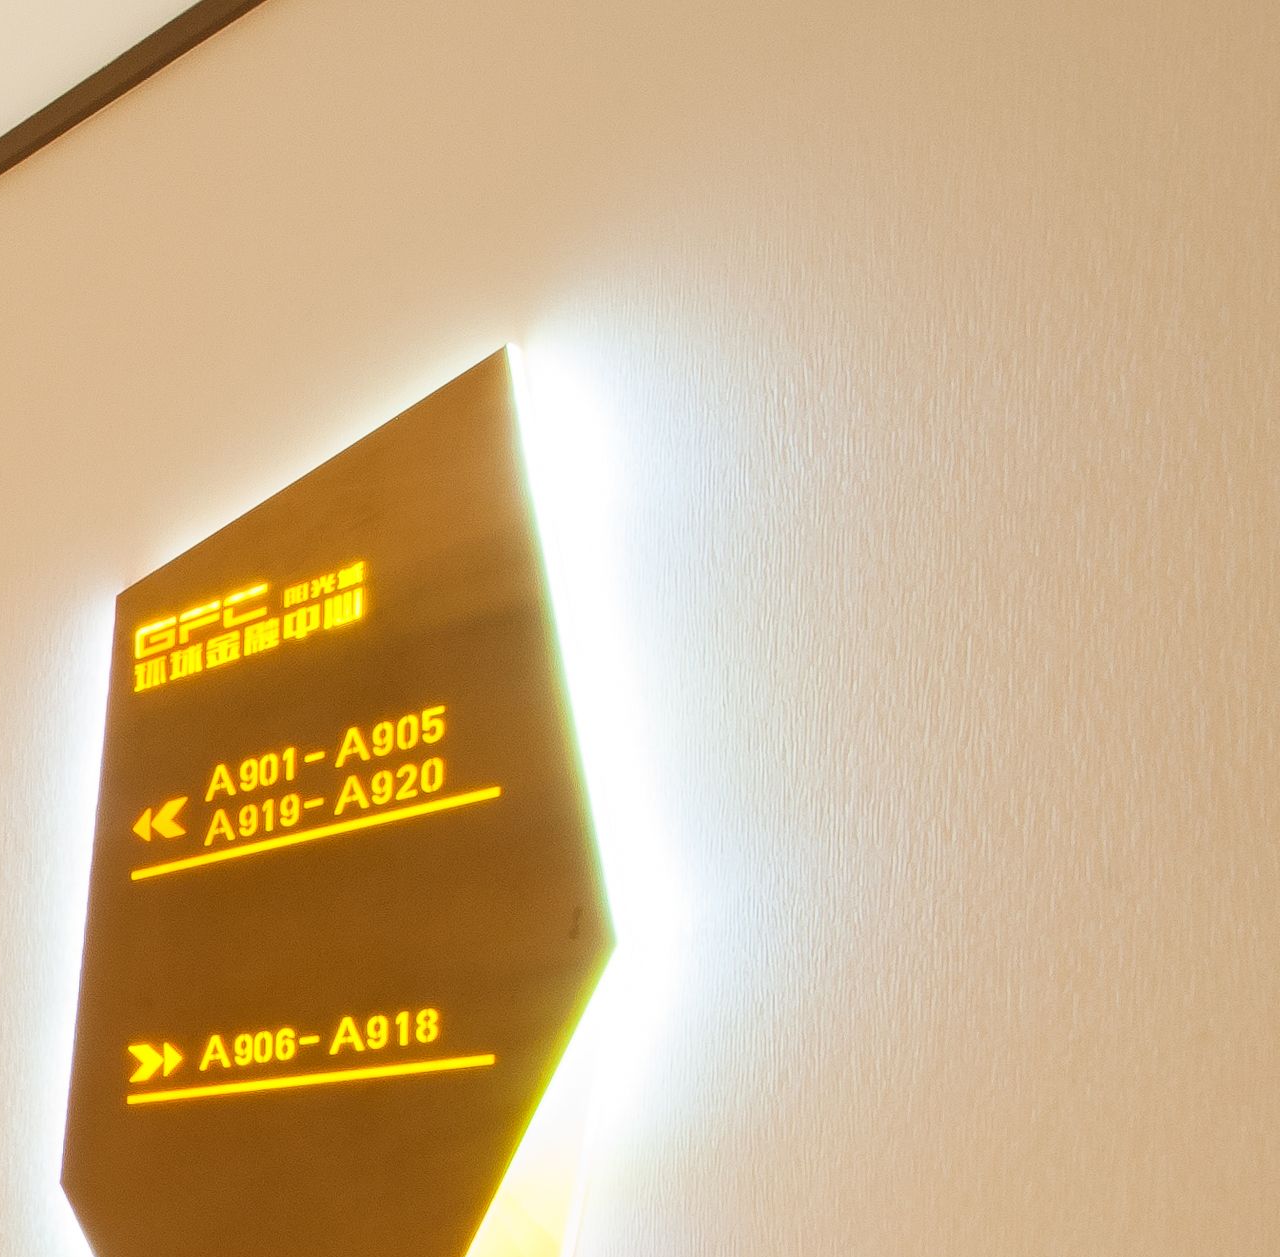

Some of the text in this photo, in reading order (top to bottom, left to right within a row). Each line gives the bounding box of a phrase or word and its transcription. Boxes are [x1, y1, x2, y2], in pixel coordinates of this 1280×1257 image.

[133, 586, 367, 693] 环球金融中心
[134, 581, 269, 660] GFC
